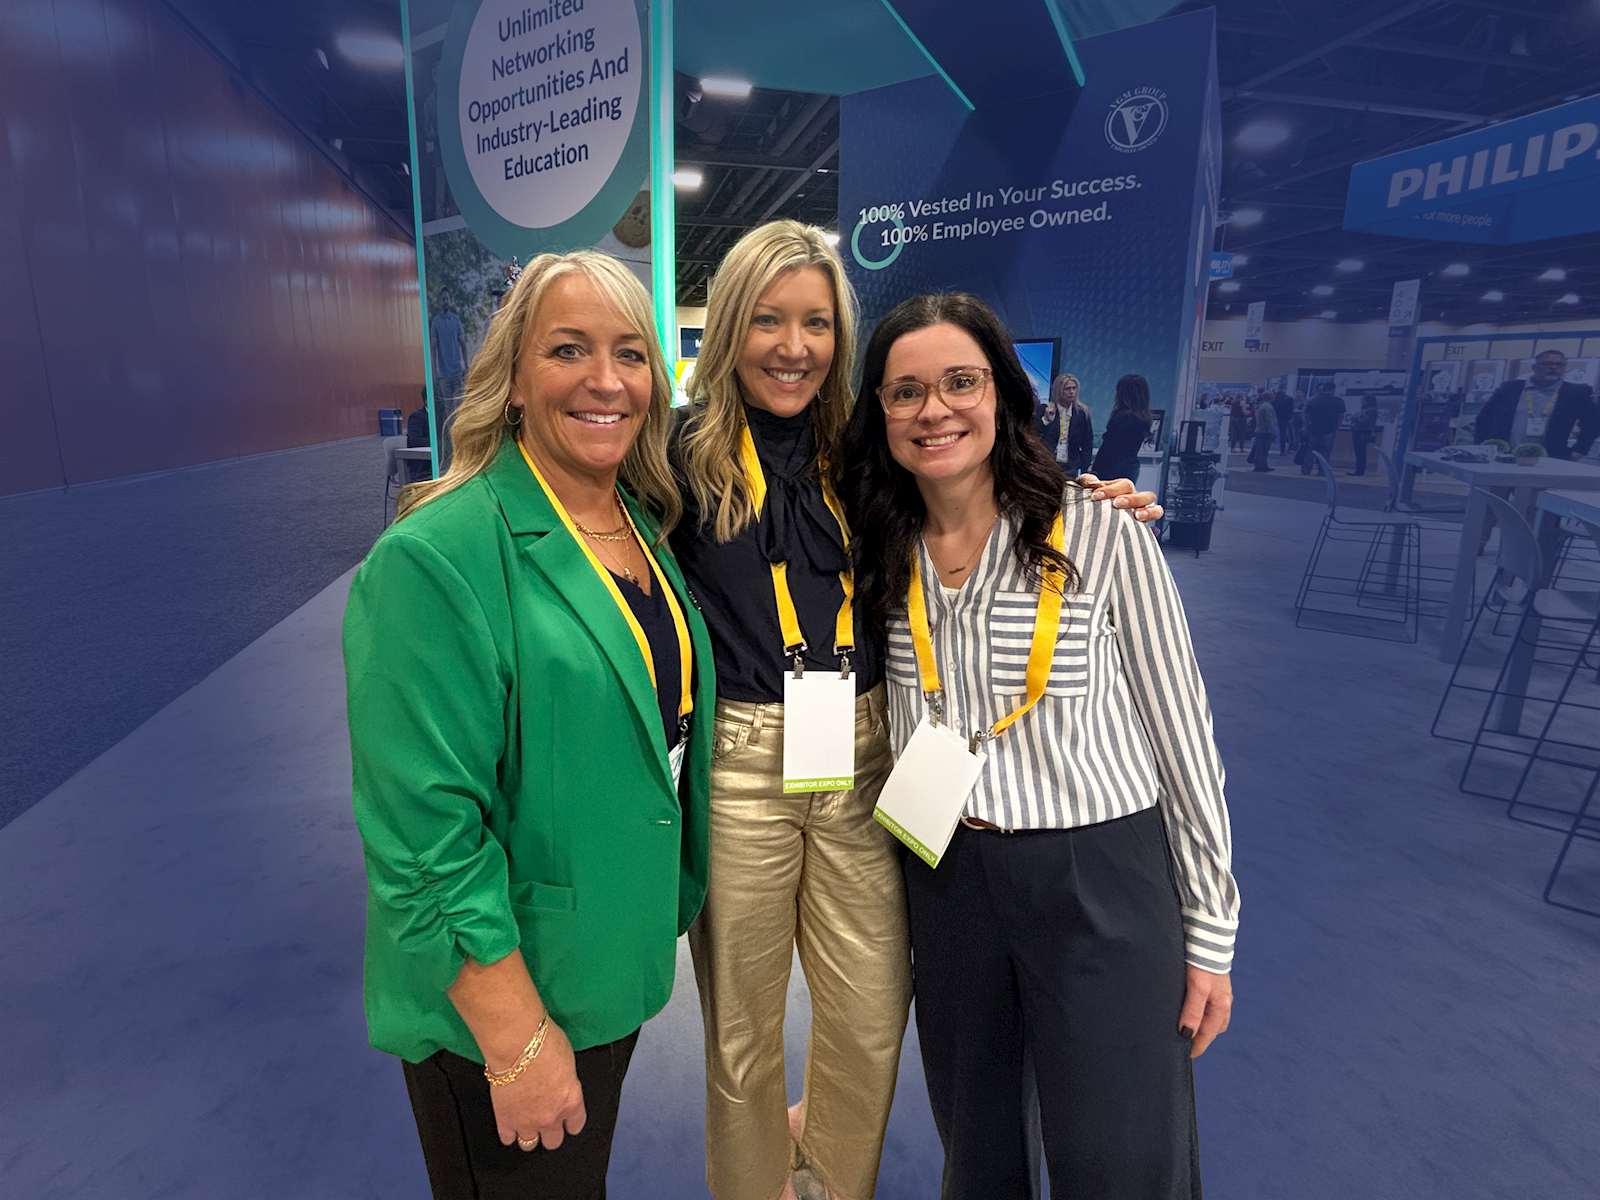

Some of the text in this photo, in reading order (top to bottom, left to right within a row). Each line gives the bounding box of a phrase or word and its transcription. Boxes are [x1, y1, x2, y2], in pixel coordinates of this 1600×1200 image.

[498, 0, 585, 43] Unlimited
[491, 27, 596, 82] Networking
[467, 47, 630, 124] Opportunities And
[1109, 86, 1167, 108] VGM GROUP
[476, 96, 623, 155] Industry-Leading
[503, 143, 590, 181] Education
[1386, 122, 1600, 209] PHILIP
[858, 173, 1143, 226] 100% Vested In Your Success.
[1437, 212, 1461, 223] more
[1461, 213, 1493, 229] people
[880, 202, 1113, 247] 100% Employee Owned.
[1201, 341, 1225, 352] EXIT
[785, 779, 852, 790] EXHIBITOR EXPO ONLY
[873, 808, 936, 862] EXHIBITOR EXPO ONLY
